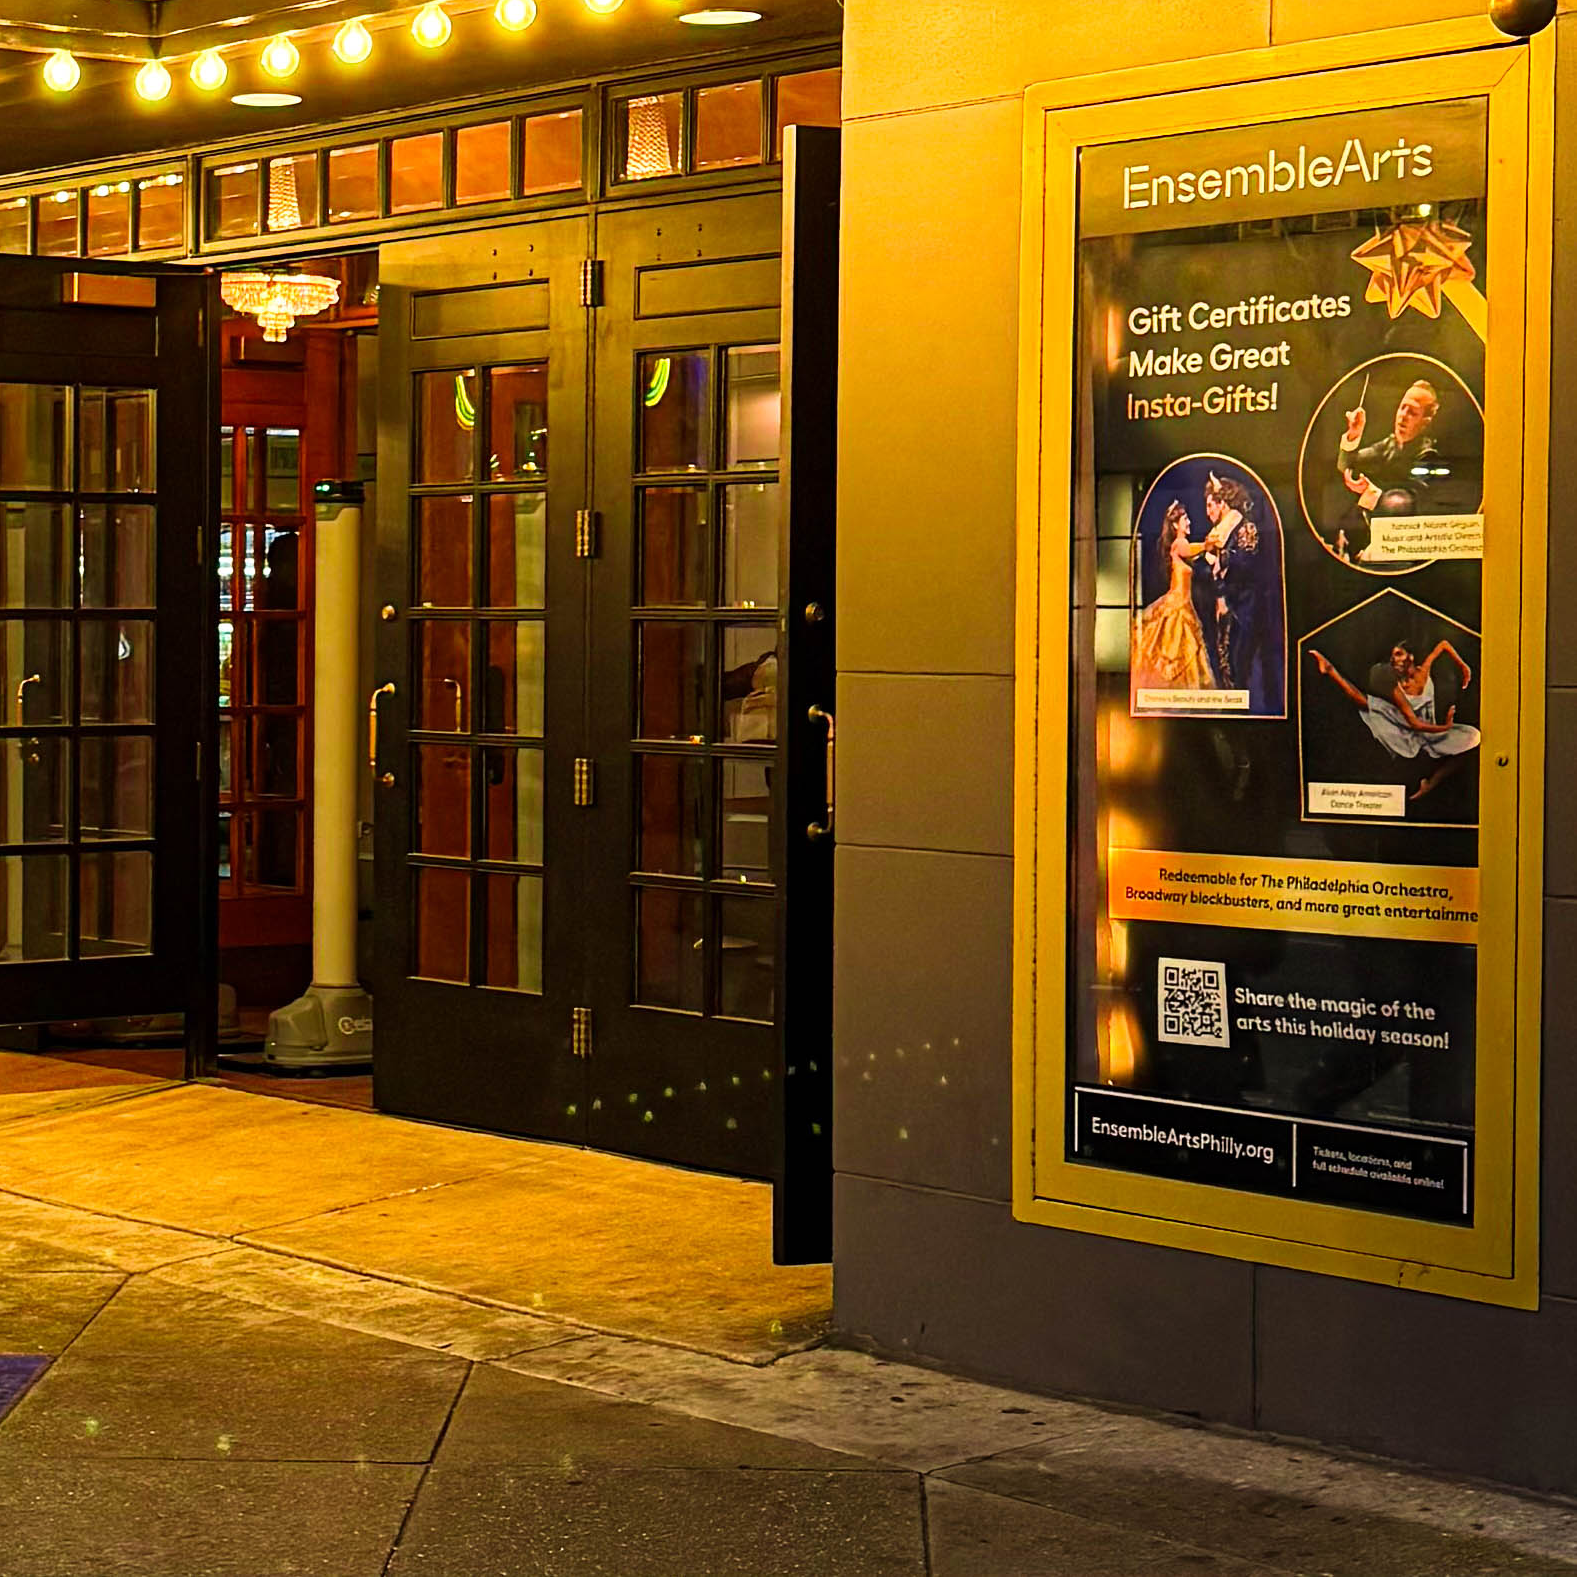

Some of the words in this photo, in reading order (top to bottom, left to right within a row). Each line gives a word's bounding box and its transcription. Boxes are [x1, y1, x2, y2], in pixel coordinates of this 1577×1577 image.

[1123, 138, 1433, 209] EnsembleArts
[1128, 304, 1182, 335] Gift
[1188, 294, 1350, 330] Certificates
[1128, 347, 1203, 377] Make
[1209, 340, 1291, 371] Great
[1127, 382, 1278, 420] Insta-Gifts!
[1125, 886, 1188, 906] Broadway
[1190, 890, 1274, 911] blockbusters,
[1276, 898, 1302, 912] and
[1304, 900, 1339, 914] more
[1342, 903, 1381, 918] great
[1159, 868, 1237, 885] Redeemable
[1240, 873, 1257, 887] for
[1261, 874, 1284, 888] The
[1286, 876, 1369, 895] Philadelphia
[1372, 881, 1454, 902] Orchestra,
[1234, 987, 1285, 1008] Share
[1288, 992, 1317, 1011] the
[1321, 998, 1377, 1018] magic
[1381, 1000, 1400, 1018] of
[1404, 1002, 1436, 1021] the
[1236, 1017, 1272, 1033] arts
[1275, 1017, 1307, 1036] this
[1310, 1020, 1376, 1045] holiday
[1380, 1030, 1450, 1050] season!
[1091, 1117, 1274, 1164] EnsembleArtsPhilly.org
